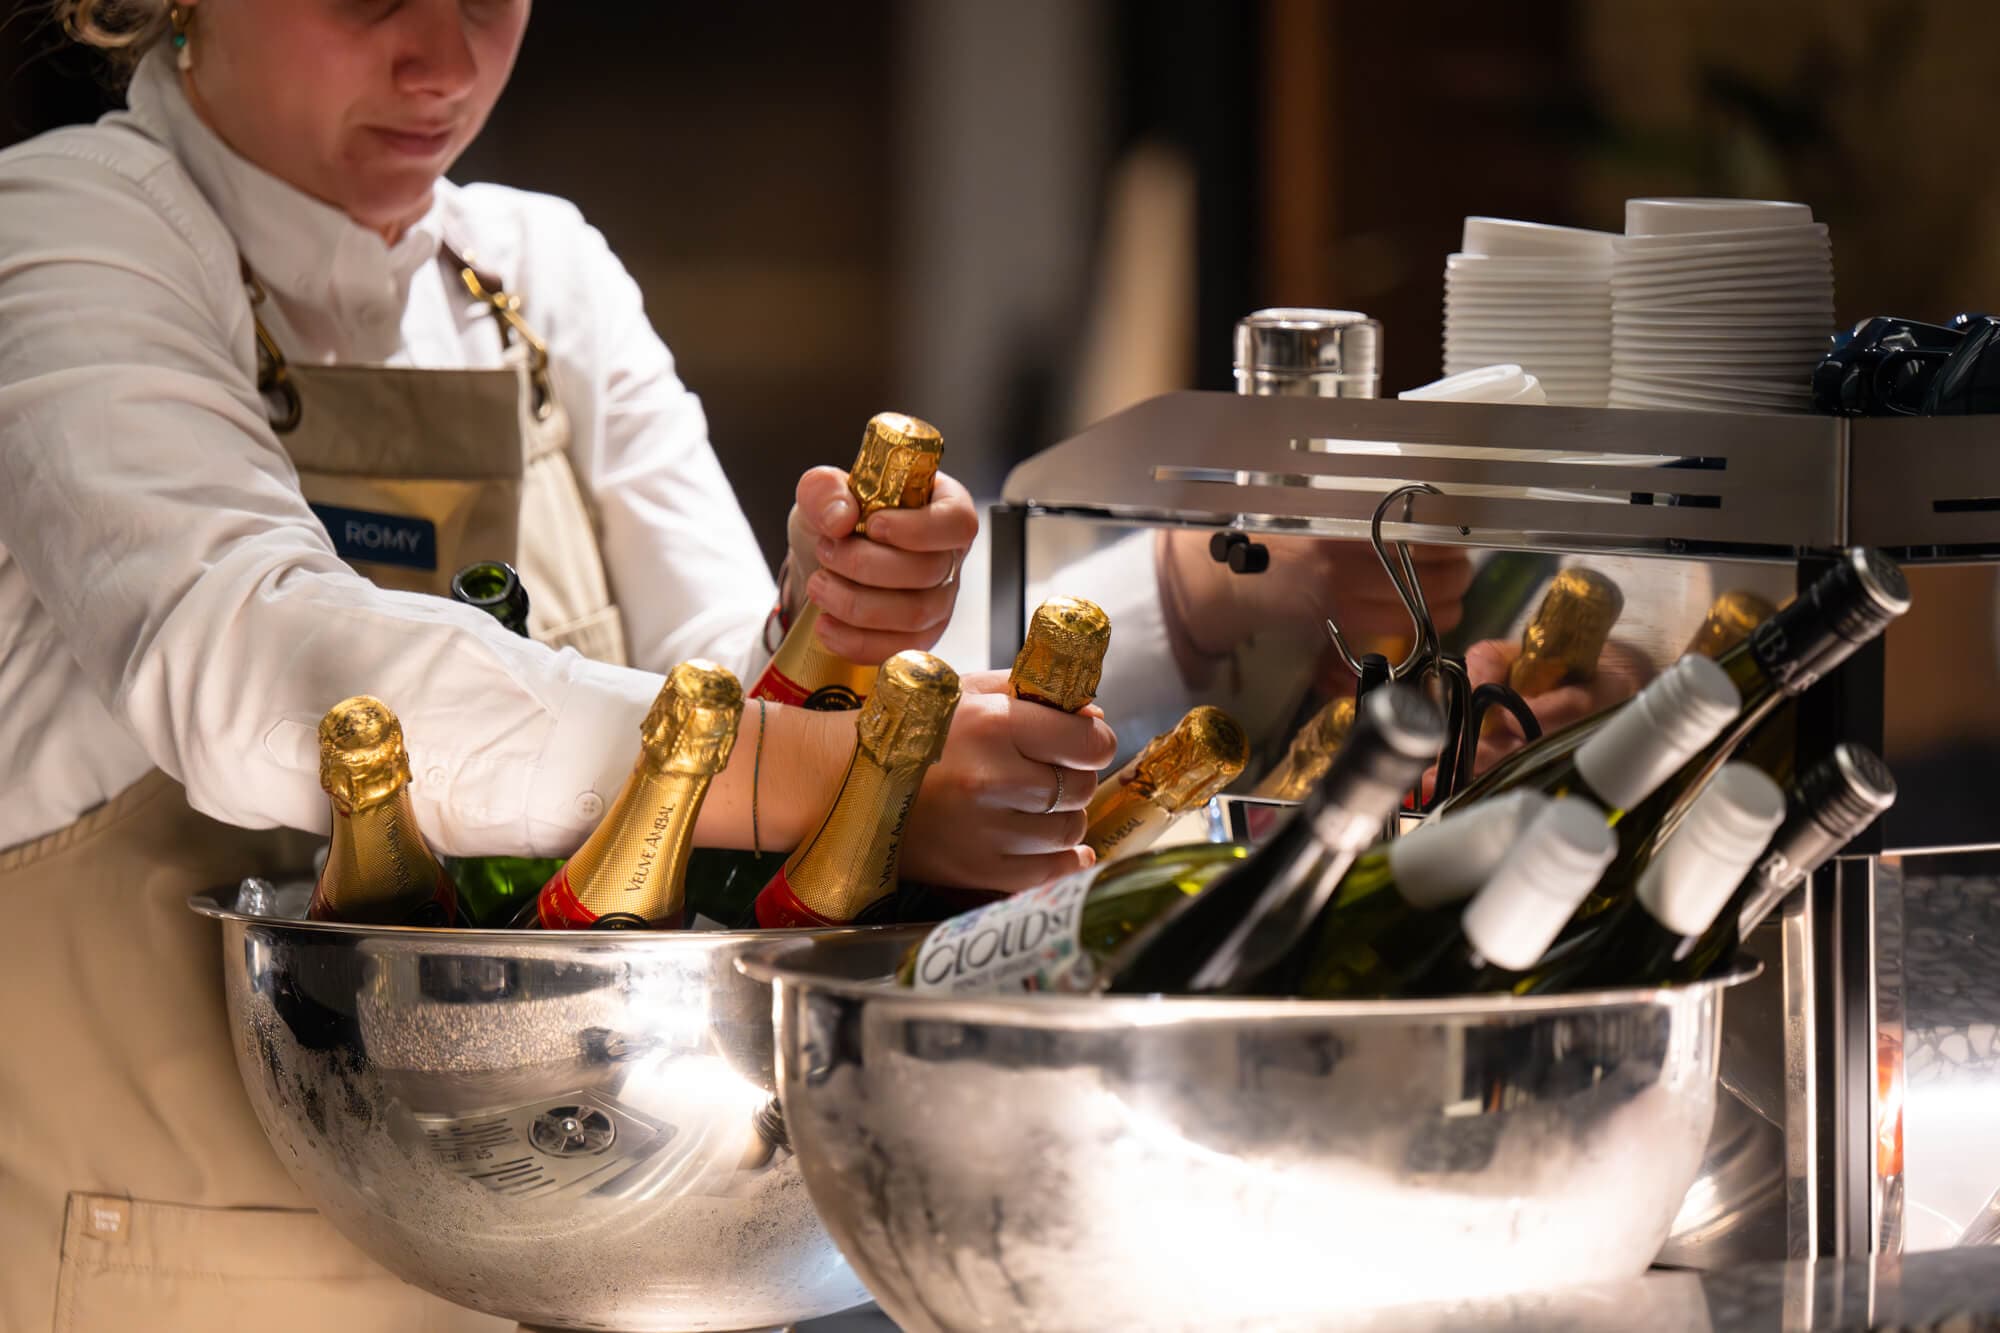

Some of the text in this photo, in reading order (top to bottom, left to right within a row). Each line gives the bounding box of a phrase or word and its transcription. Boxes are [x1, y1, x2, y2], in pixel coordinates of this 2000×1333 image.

[345, 520, 421, 554] ROMY
[624, 803, 677, 892] VEUVE AMBAL
